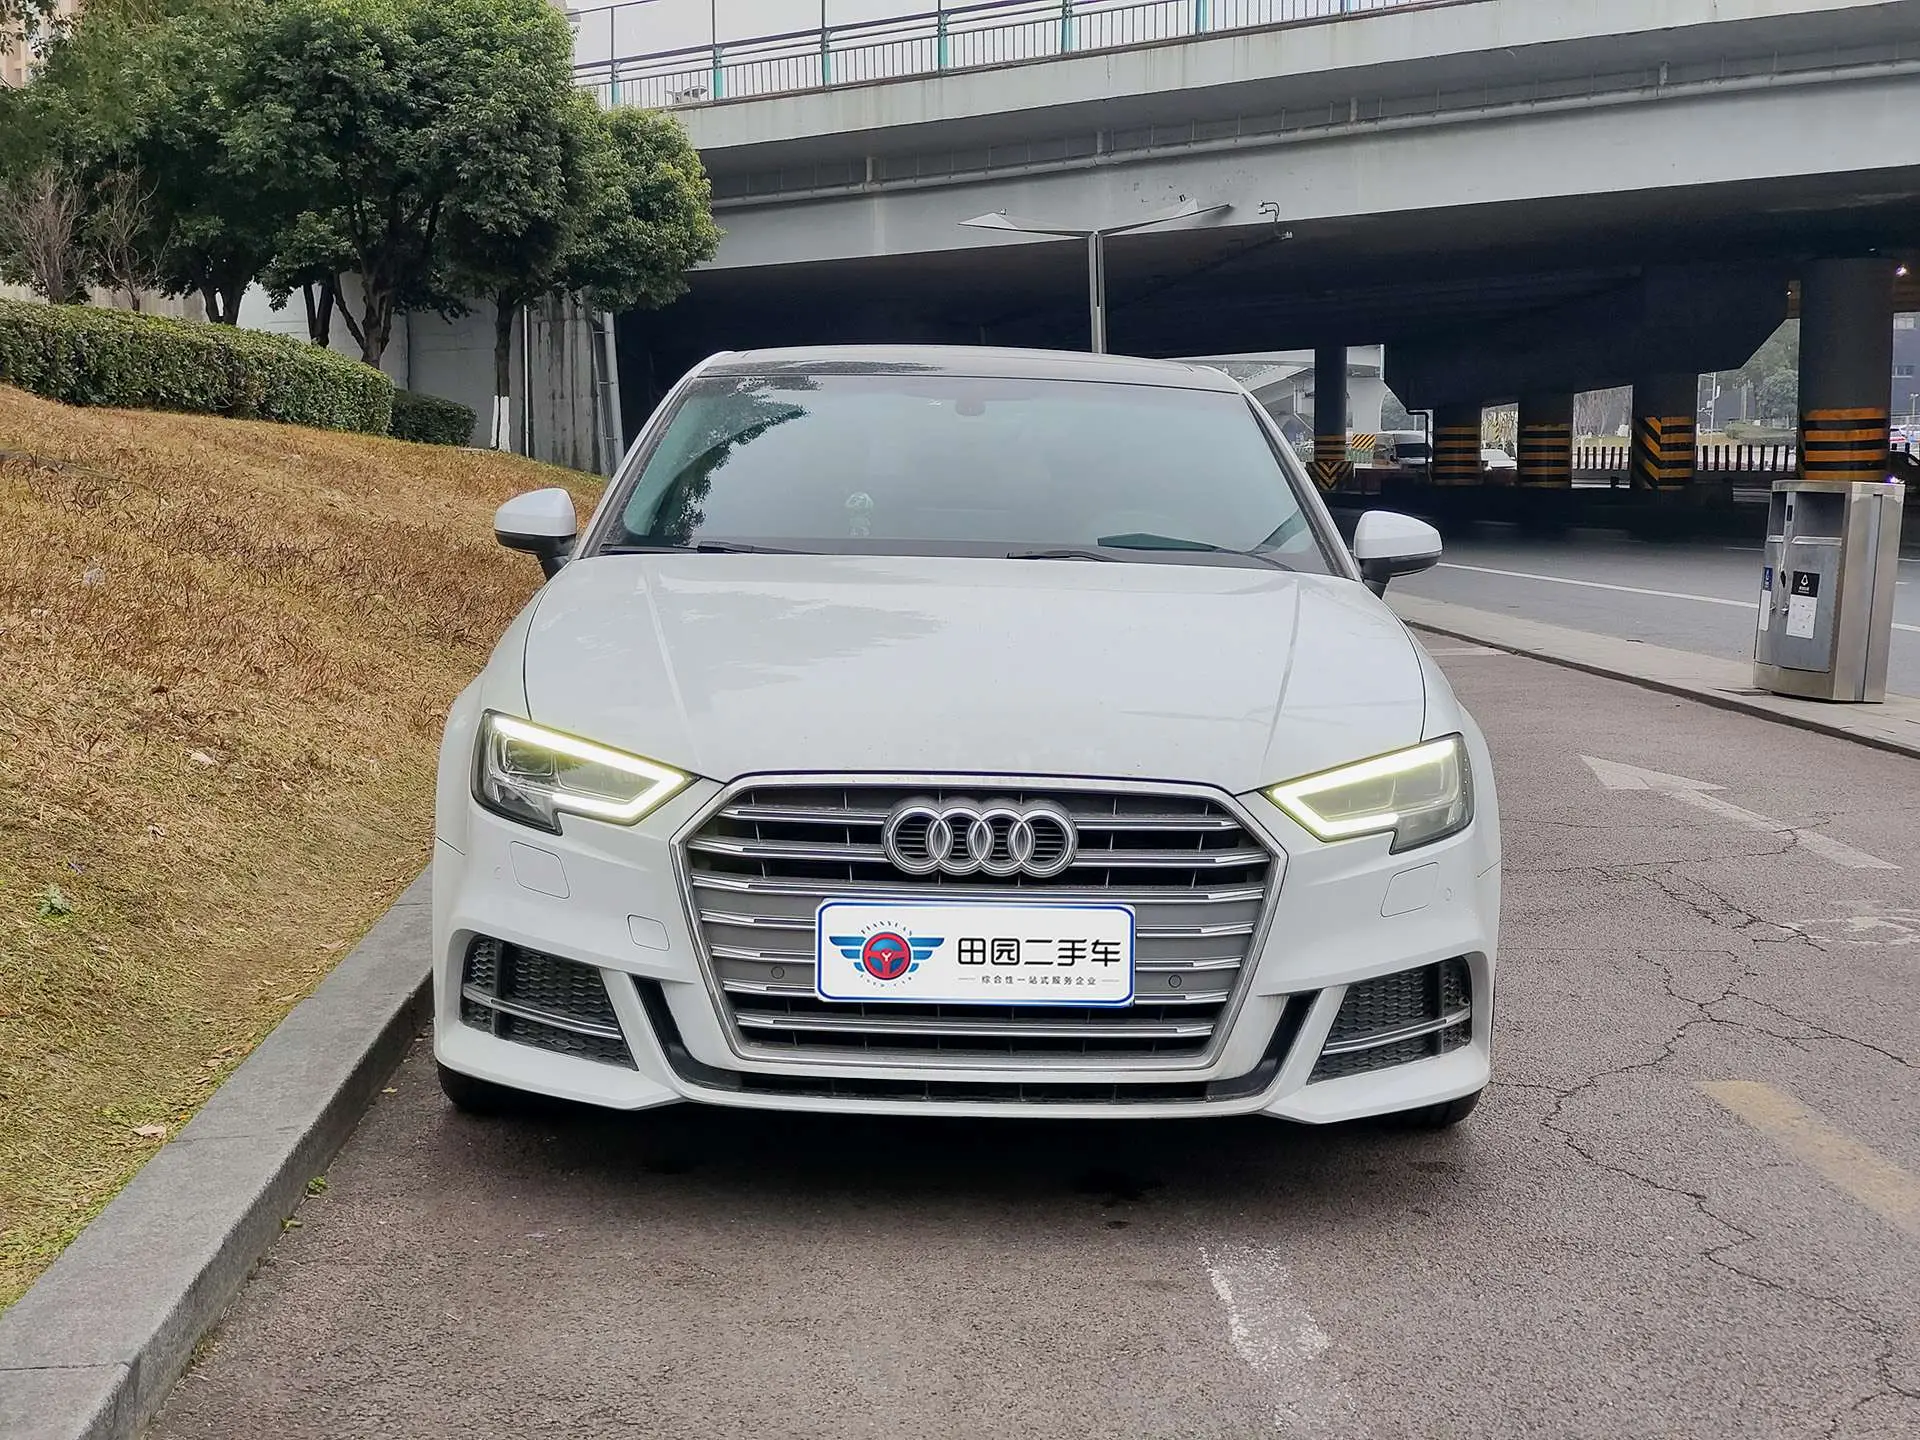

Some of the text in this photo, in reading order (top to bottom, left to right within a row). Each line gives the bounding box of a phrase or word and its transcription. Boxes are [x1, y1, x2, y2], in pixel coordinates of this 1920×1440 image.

[958, 938, 1121, 967] 田园二手车
[981, 975, 1096, 986] 综合性一站式服务企业
